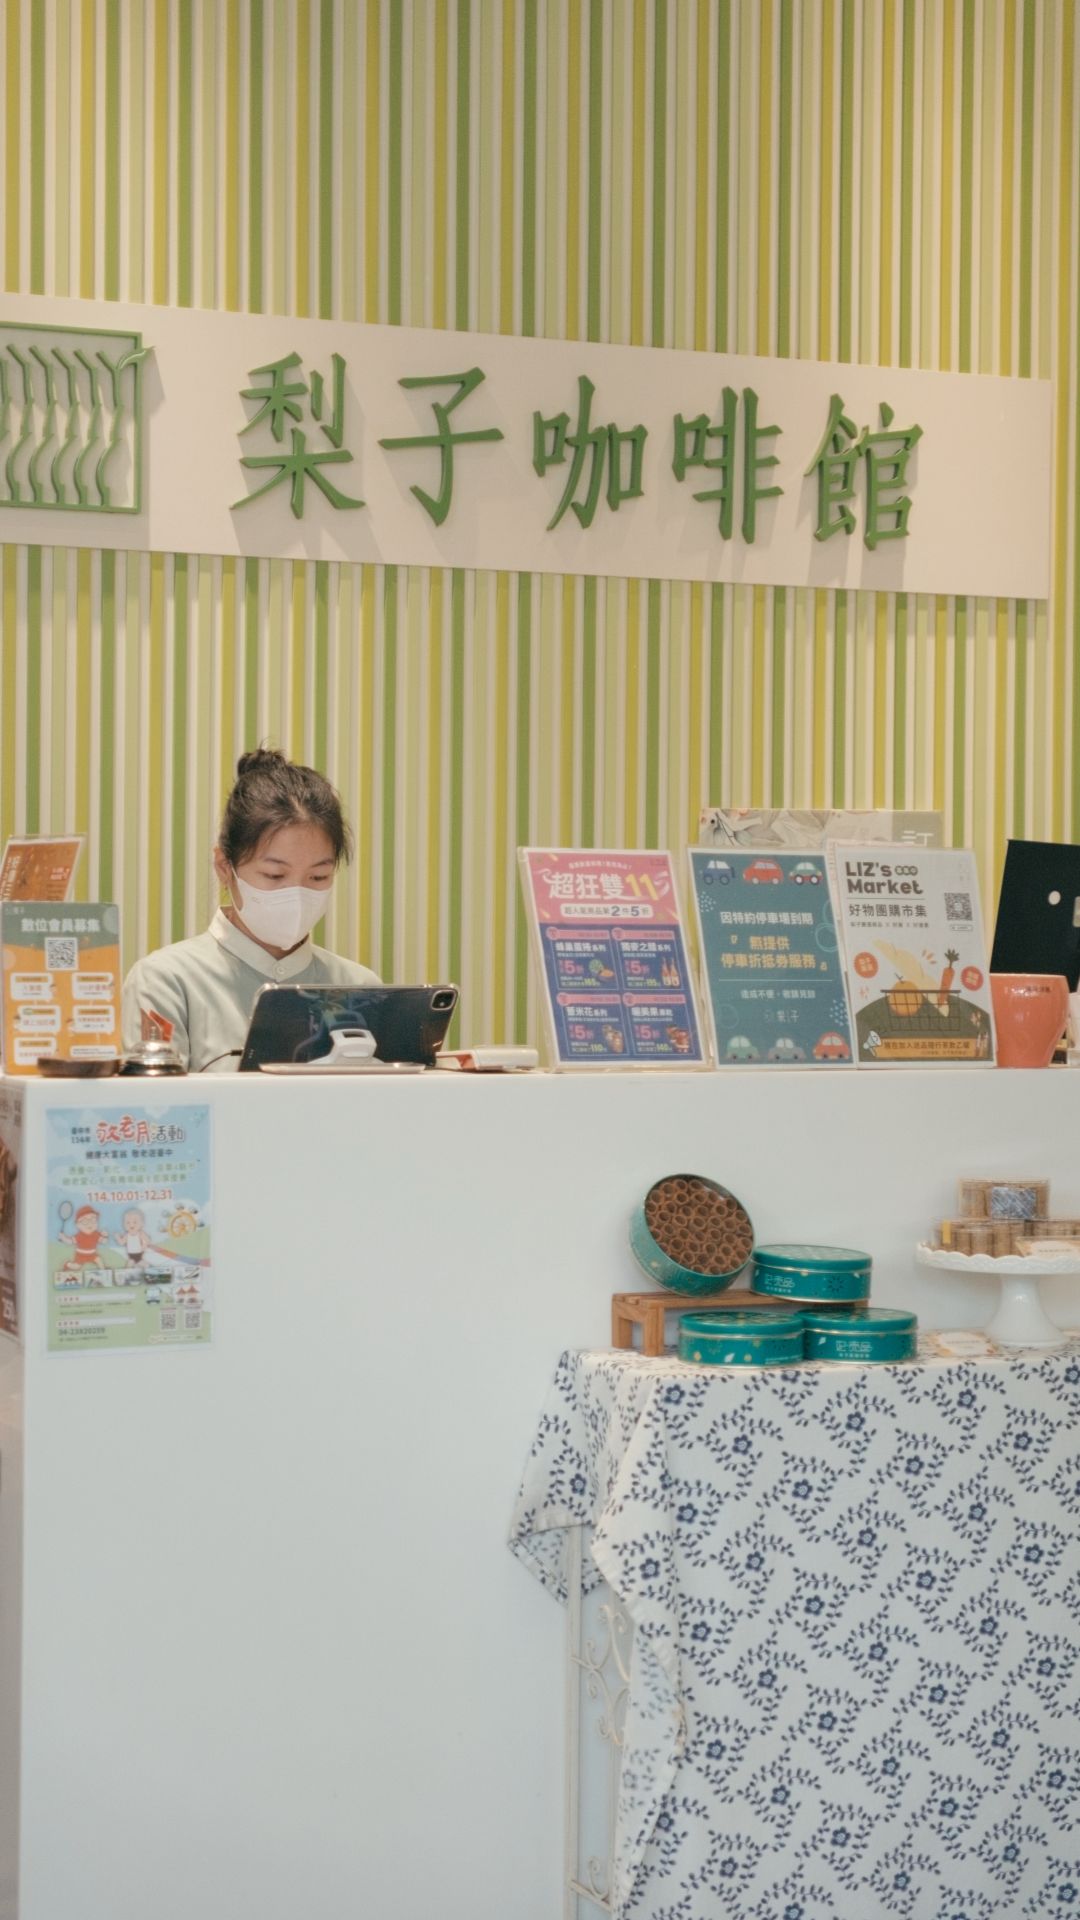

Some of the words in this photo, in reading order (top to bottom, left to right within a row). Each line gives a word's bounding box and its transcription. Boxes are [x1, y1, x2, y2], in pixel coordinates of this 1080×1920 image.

[230, 351, 924, 551] 梨子咖啡館
[845, 861, 892, 877] LIZ's
[549, 873, 659, 901] 超狂雙11
[847, 878, 924, 895] Market
[720, 911, 813, 925] 因特約停車場到期
[849, 903, 927, 918] 好物團購市集
[21, 918, 101, 933] 數位會員募集
[87, 1190, 173, 1202] 114.10.01-12.31
